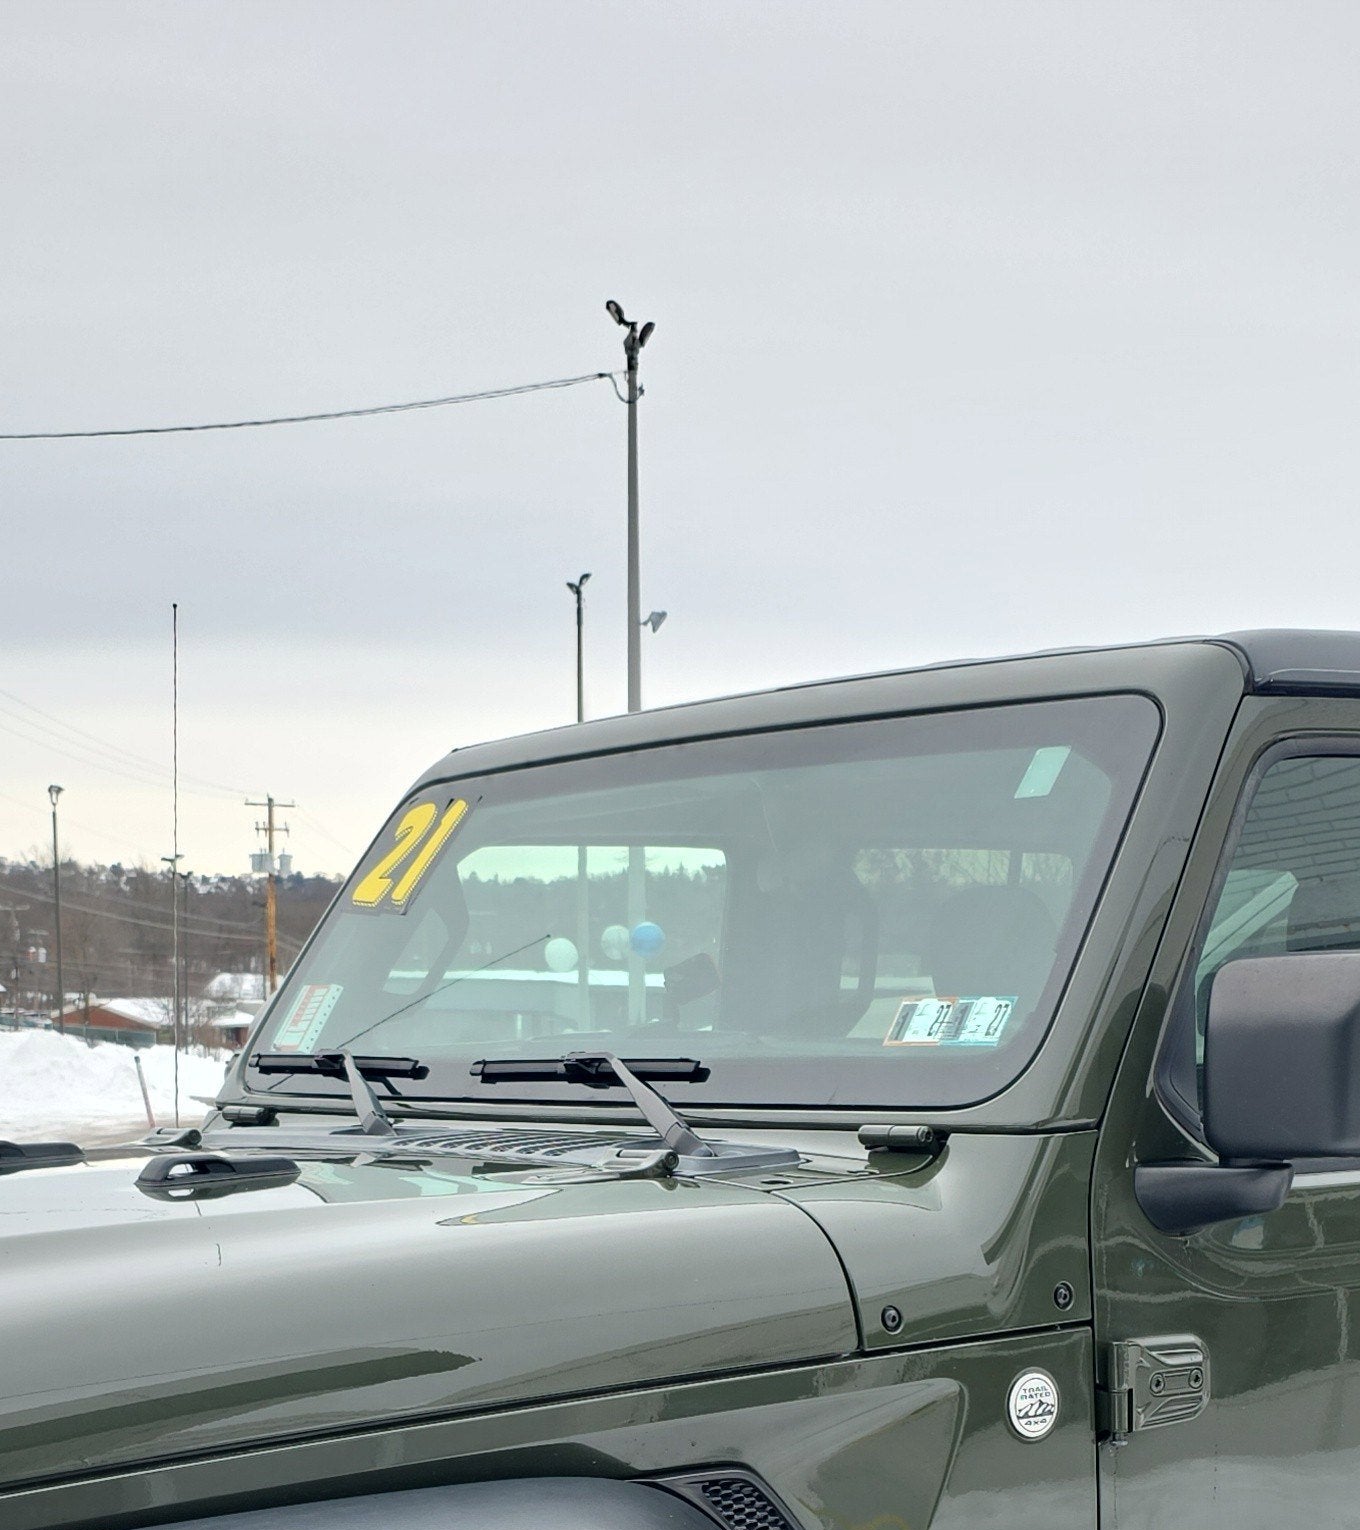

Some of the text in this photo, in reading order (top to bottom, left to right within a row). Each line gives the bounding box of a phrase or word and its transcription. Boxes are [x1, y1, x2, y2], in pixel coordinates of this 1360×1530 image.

[352, 799, 468, 907] 21
[984, 1003, 1010, 1037] 27
[1020, 1391, 1051, 1401] RATED
[1022, 1385, 1049, 1394] TRAIL
